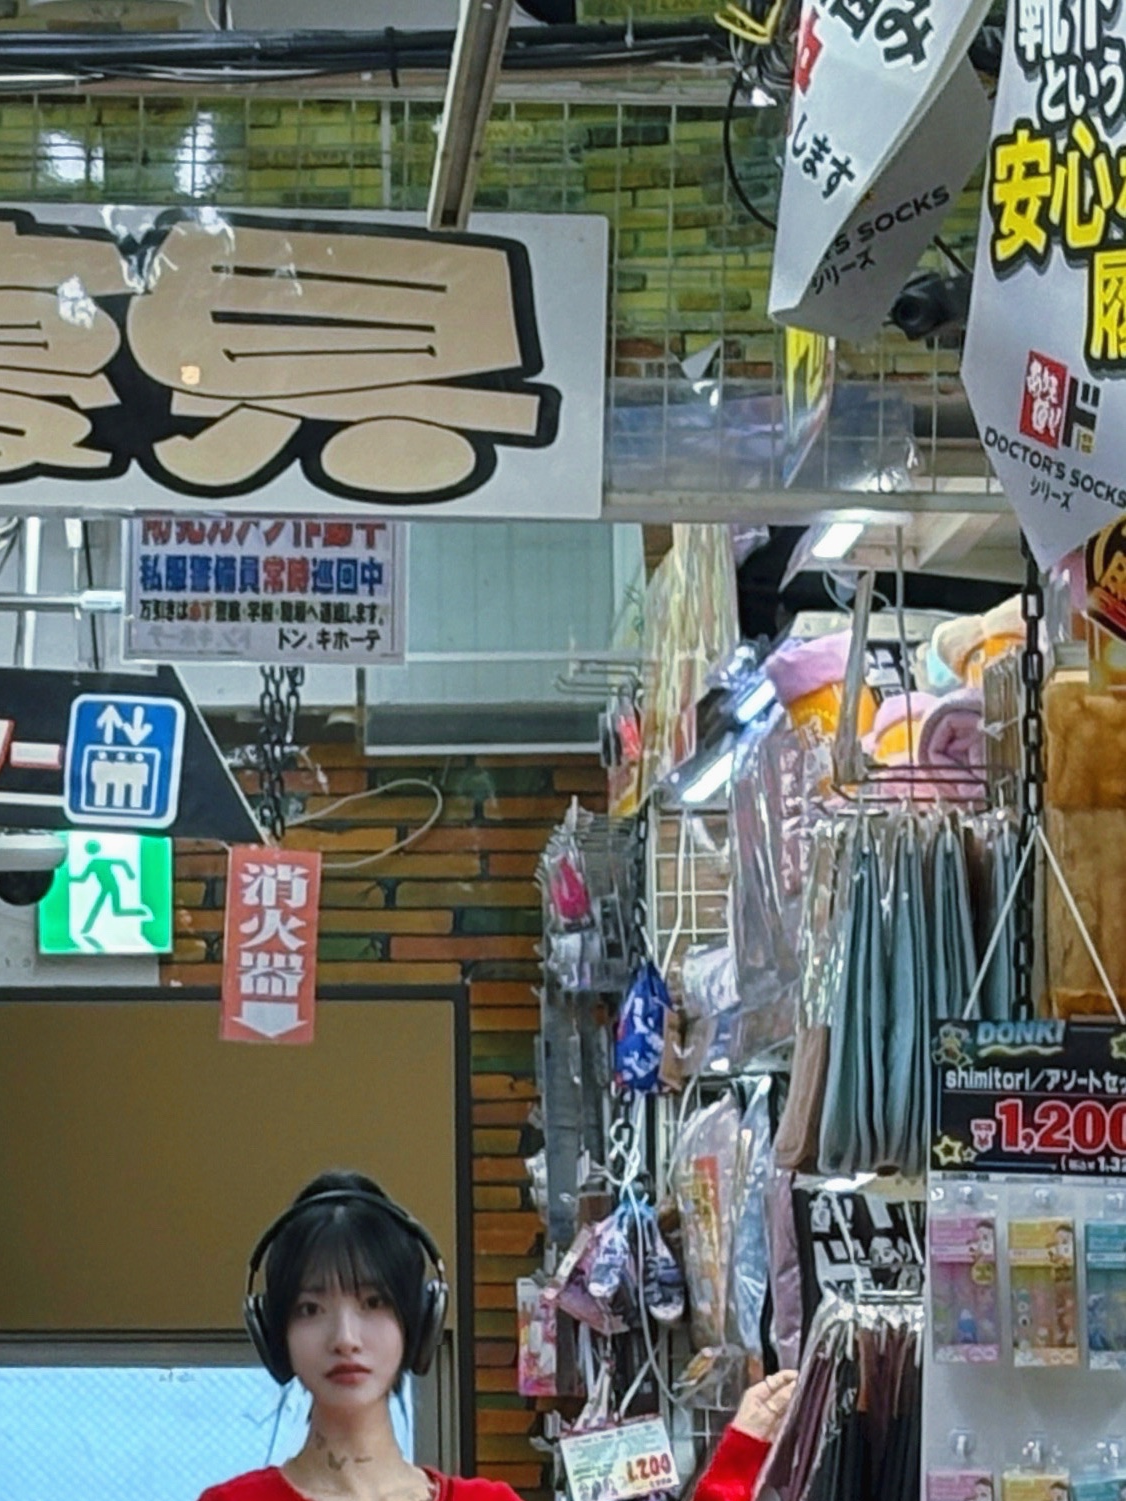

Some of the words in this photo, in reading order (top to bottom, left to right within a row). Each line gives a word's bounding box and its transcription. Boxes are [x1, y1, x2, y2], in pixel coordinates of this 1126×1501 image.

[140, 554, 384, 596] 私服警備員常時巡回中
[236, 861, 310, 1000] 消火器
[977, 1020, 1067, 1046] DONKI
